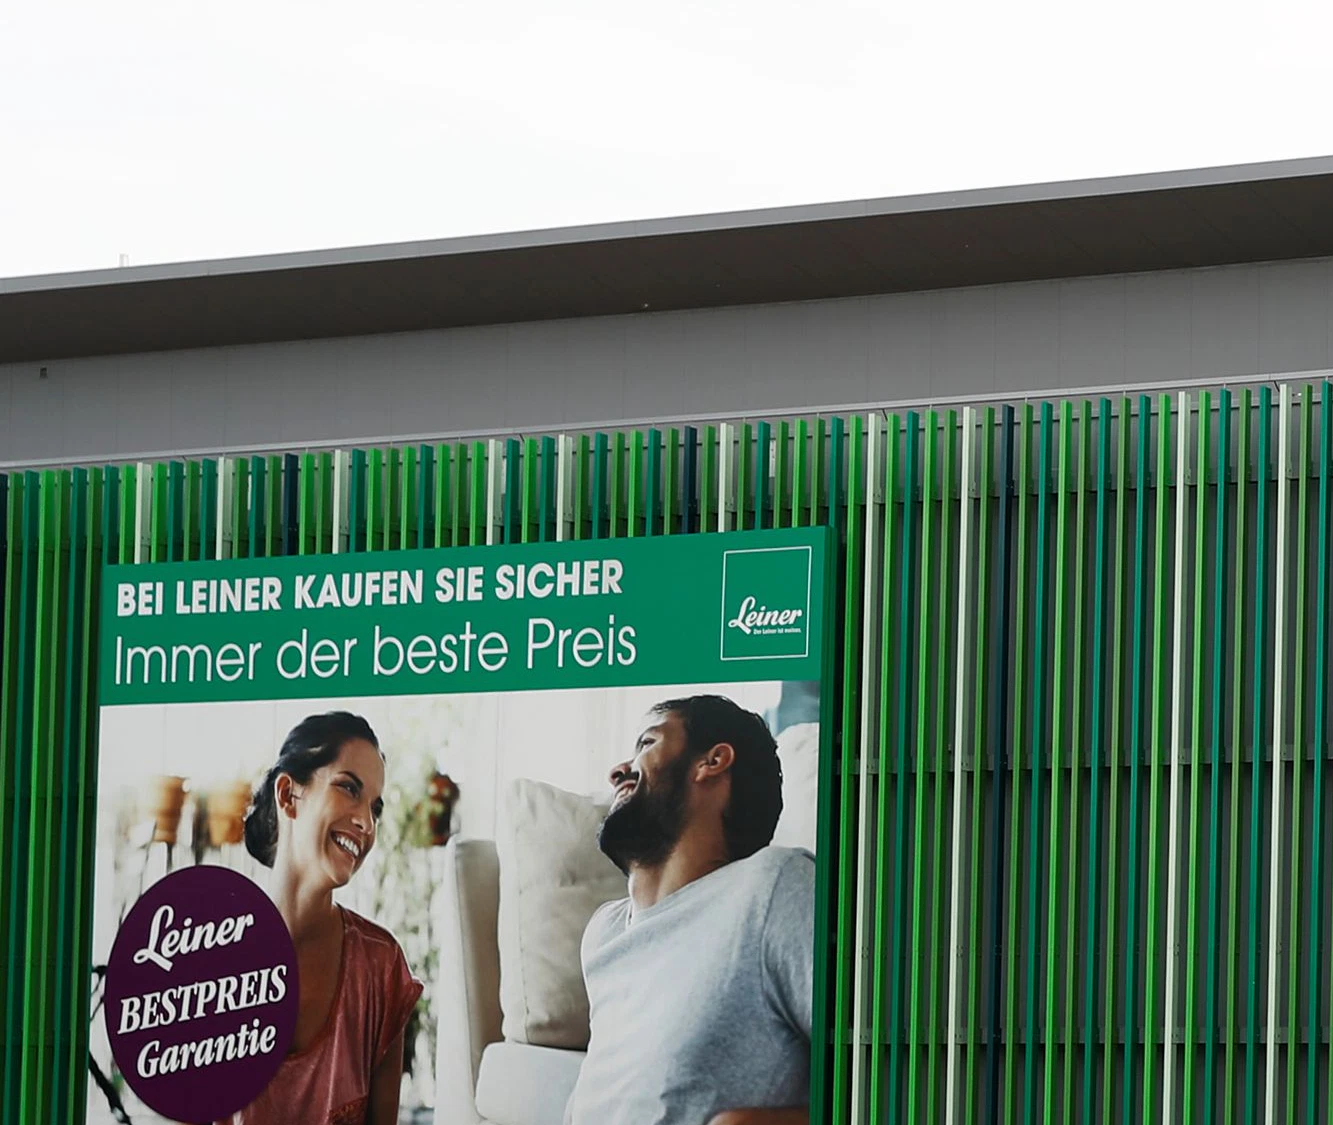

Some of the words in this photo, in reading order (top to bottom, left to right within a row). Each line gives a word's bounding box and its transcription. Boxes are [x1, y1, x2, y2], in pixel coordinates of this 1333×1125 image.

[116, 582, 164, 617] BEI
[175, 575, 283, 615] LEINER
[293, 569, 424, 609] KAUFEN
[433, 565, 484, 603] SIE
[494, 559, 624, 600] SICHER
[728, 596, 803, 635] Leiner
[114, 635, 263, 685] Immer
[275, 627, 357, 679] der
[372, 620, 509, 675] beste
[526, 615, 638, 667] Preis
[132, 904, 254, 973] Leiner
[116, 964, 288, 1036] BESTPREIS
[136, 1018, 277, 1080] Garantie
